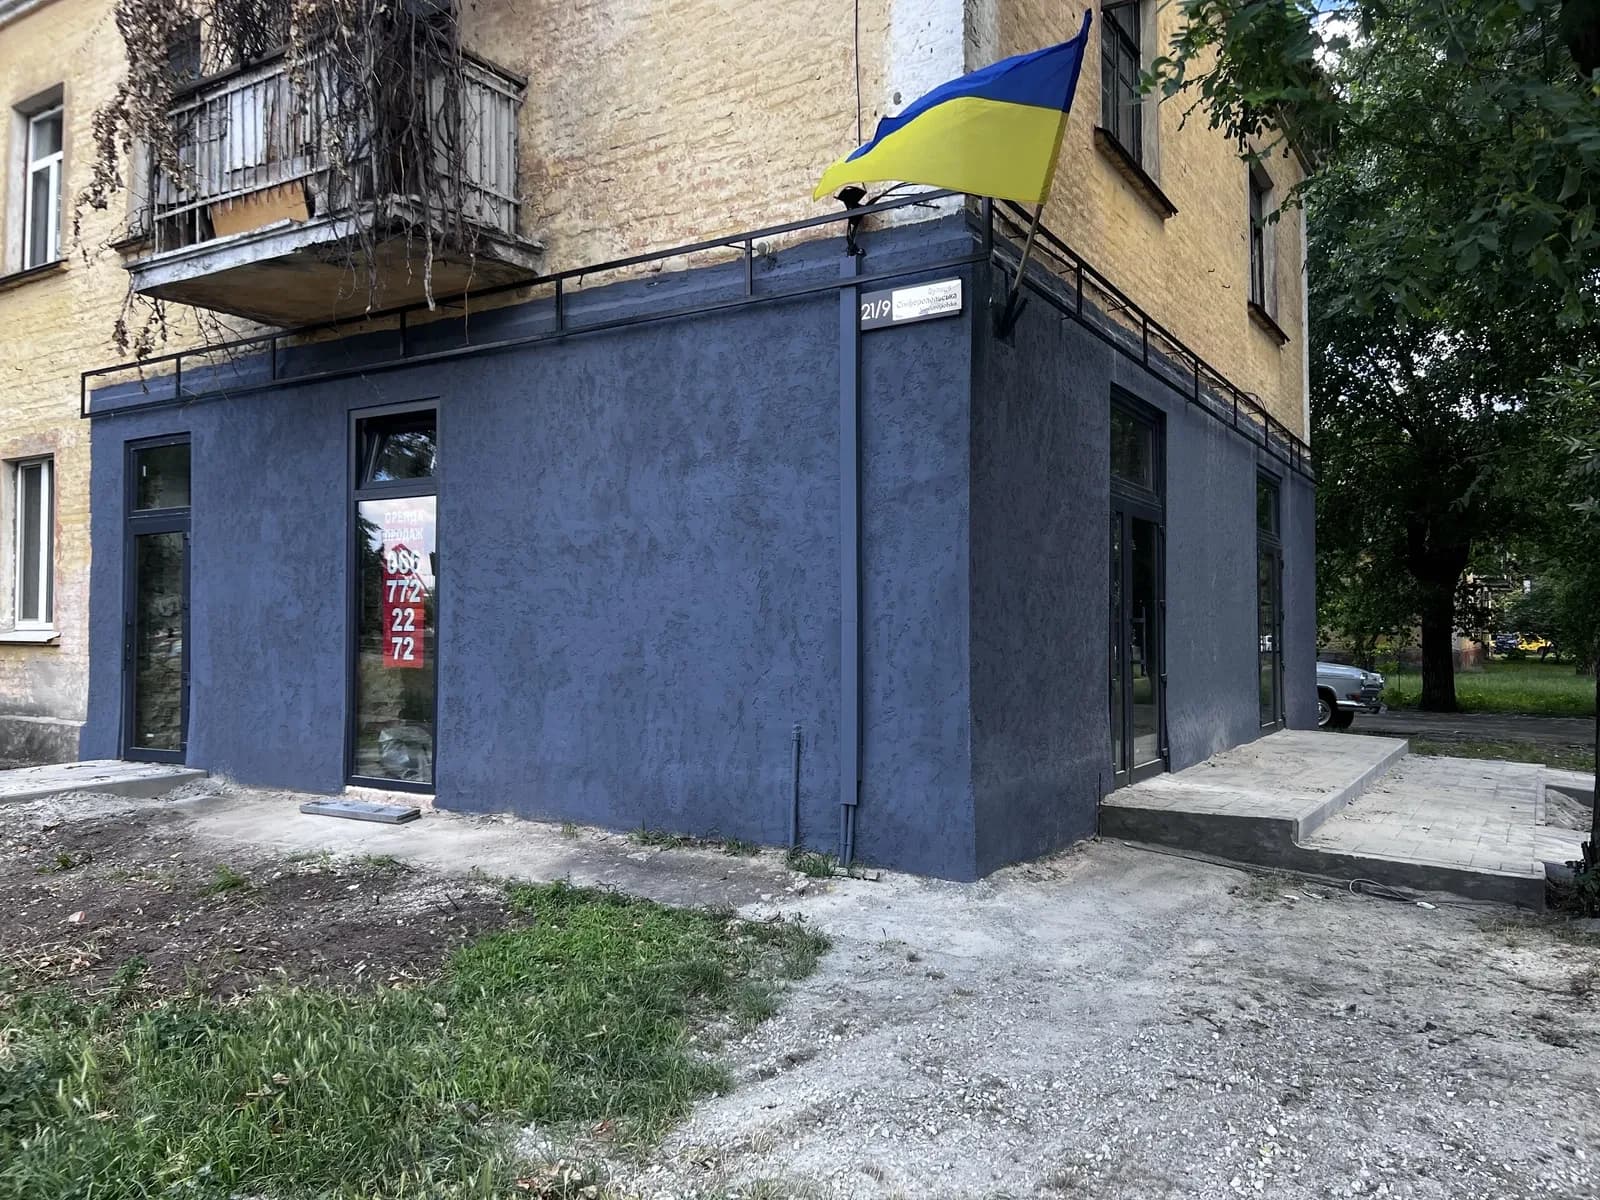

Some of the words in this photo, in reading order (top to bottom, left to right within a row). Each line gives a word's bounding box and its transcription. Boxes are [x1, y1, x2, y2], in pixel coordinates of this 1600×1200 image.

[861, 299, 891, 321] 21/9
[386, 579, 421, 603] 772
[391, 607, 415, 632] 22
[391, 637, 415, 661] 72
